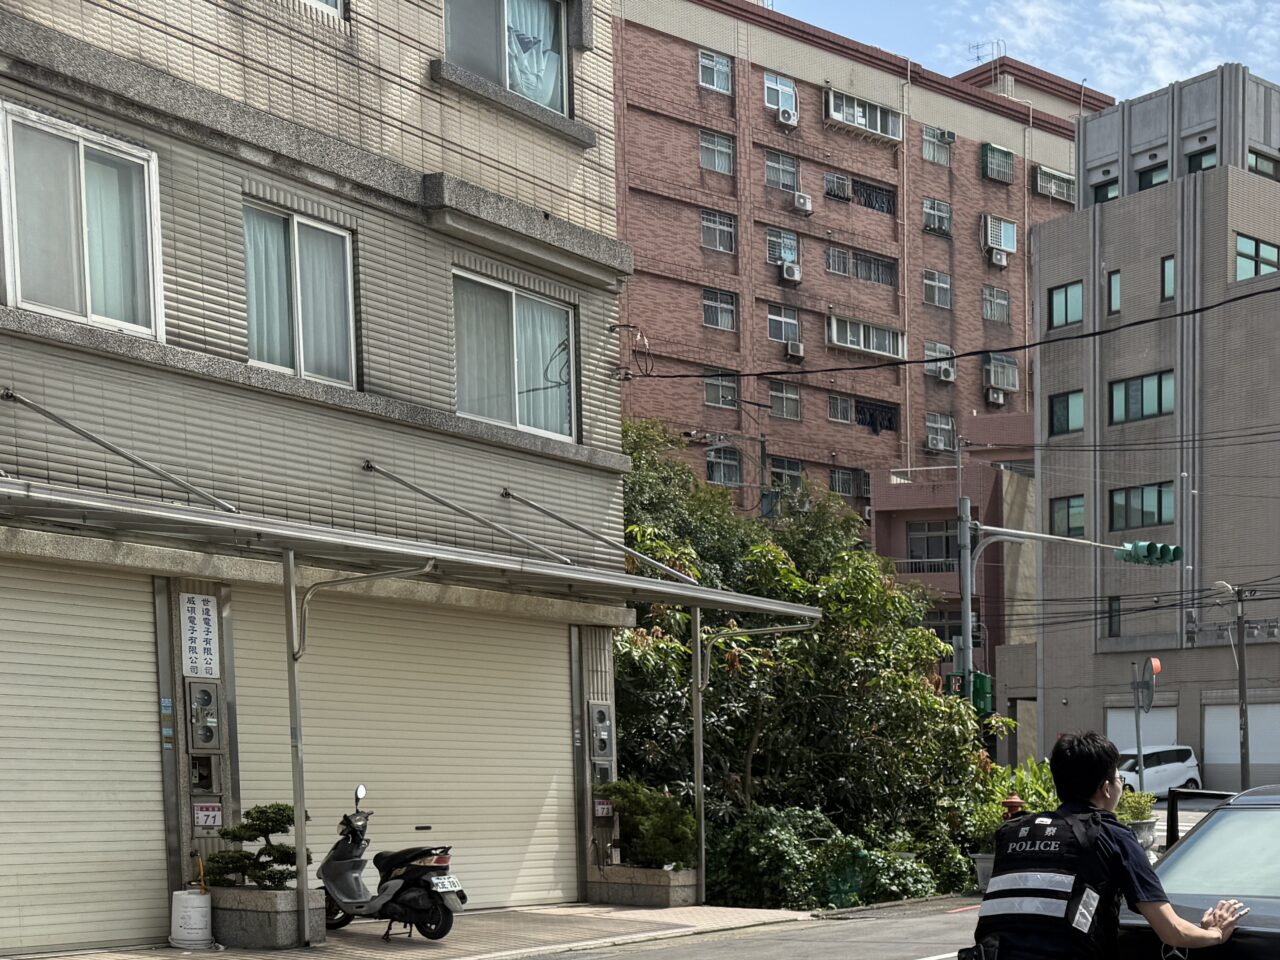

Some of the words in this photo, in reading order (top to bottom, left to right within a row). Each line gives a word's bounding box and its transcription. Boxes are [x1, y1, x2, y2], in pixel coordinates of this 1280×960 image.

[600, 807, 610, 816] 73
[203, 814, 217, 825] 71
[1007, 840, 1061, 853] POLICE
